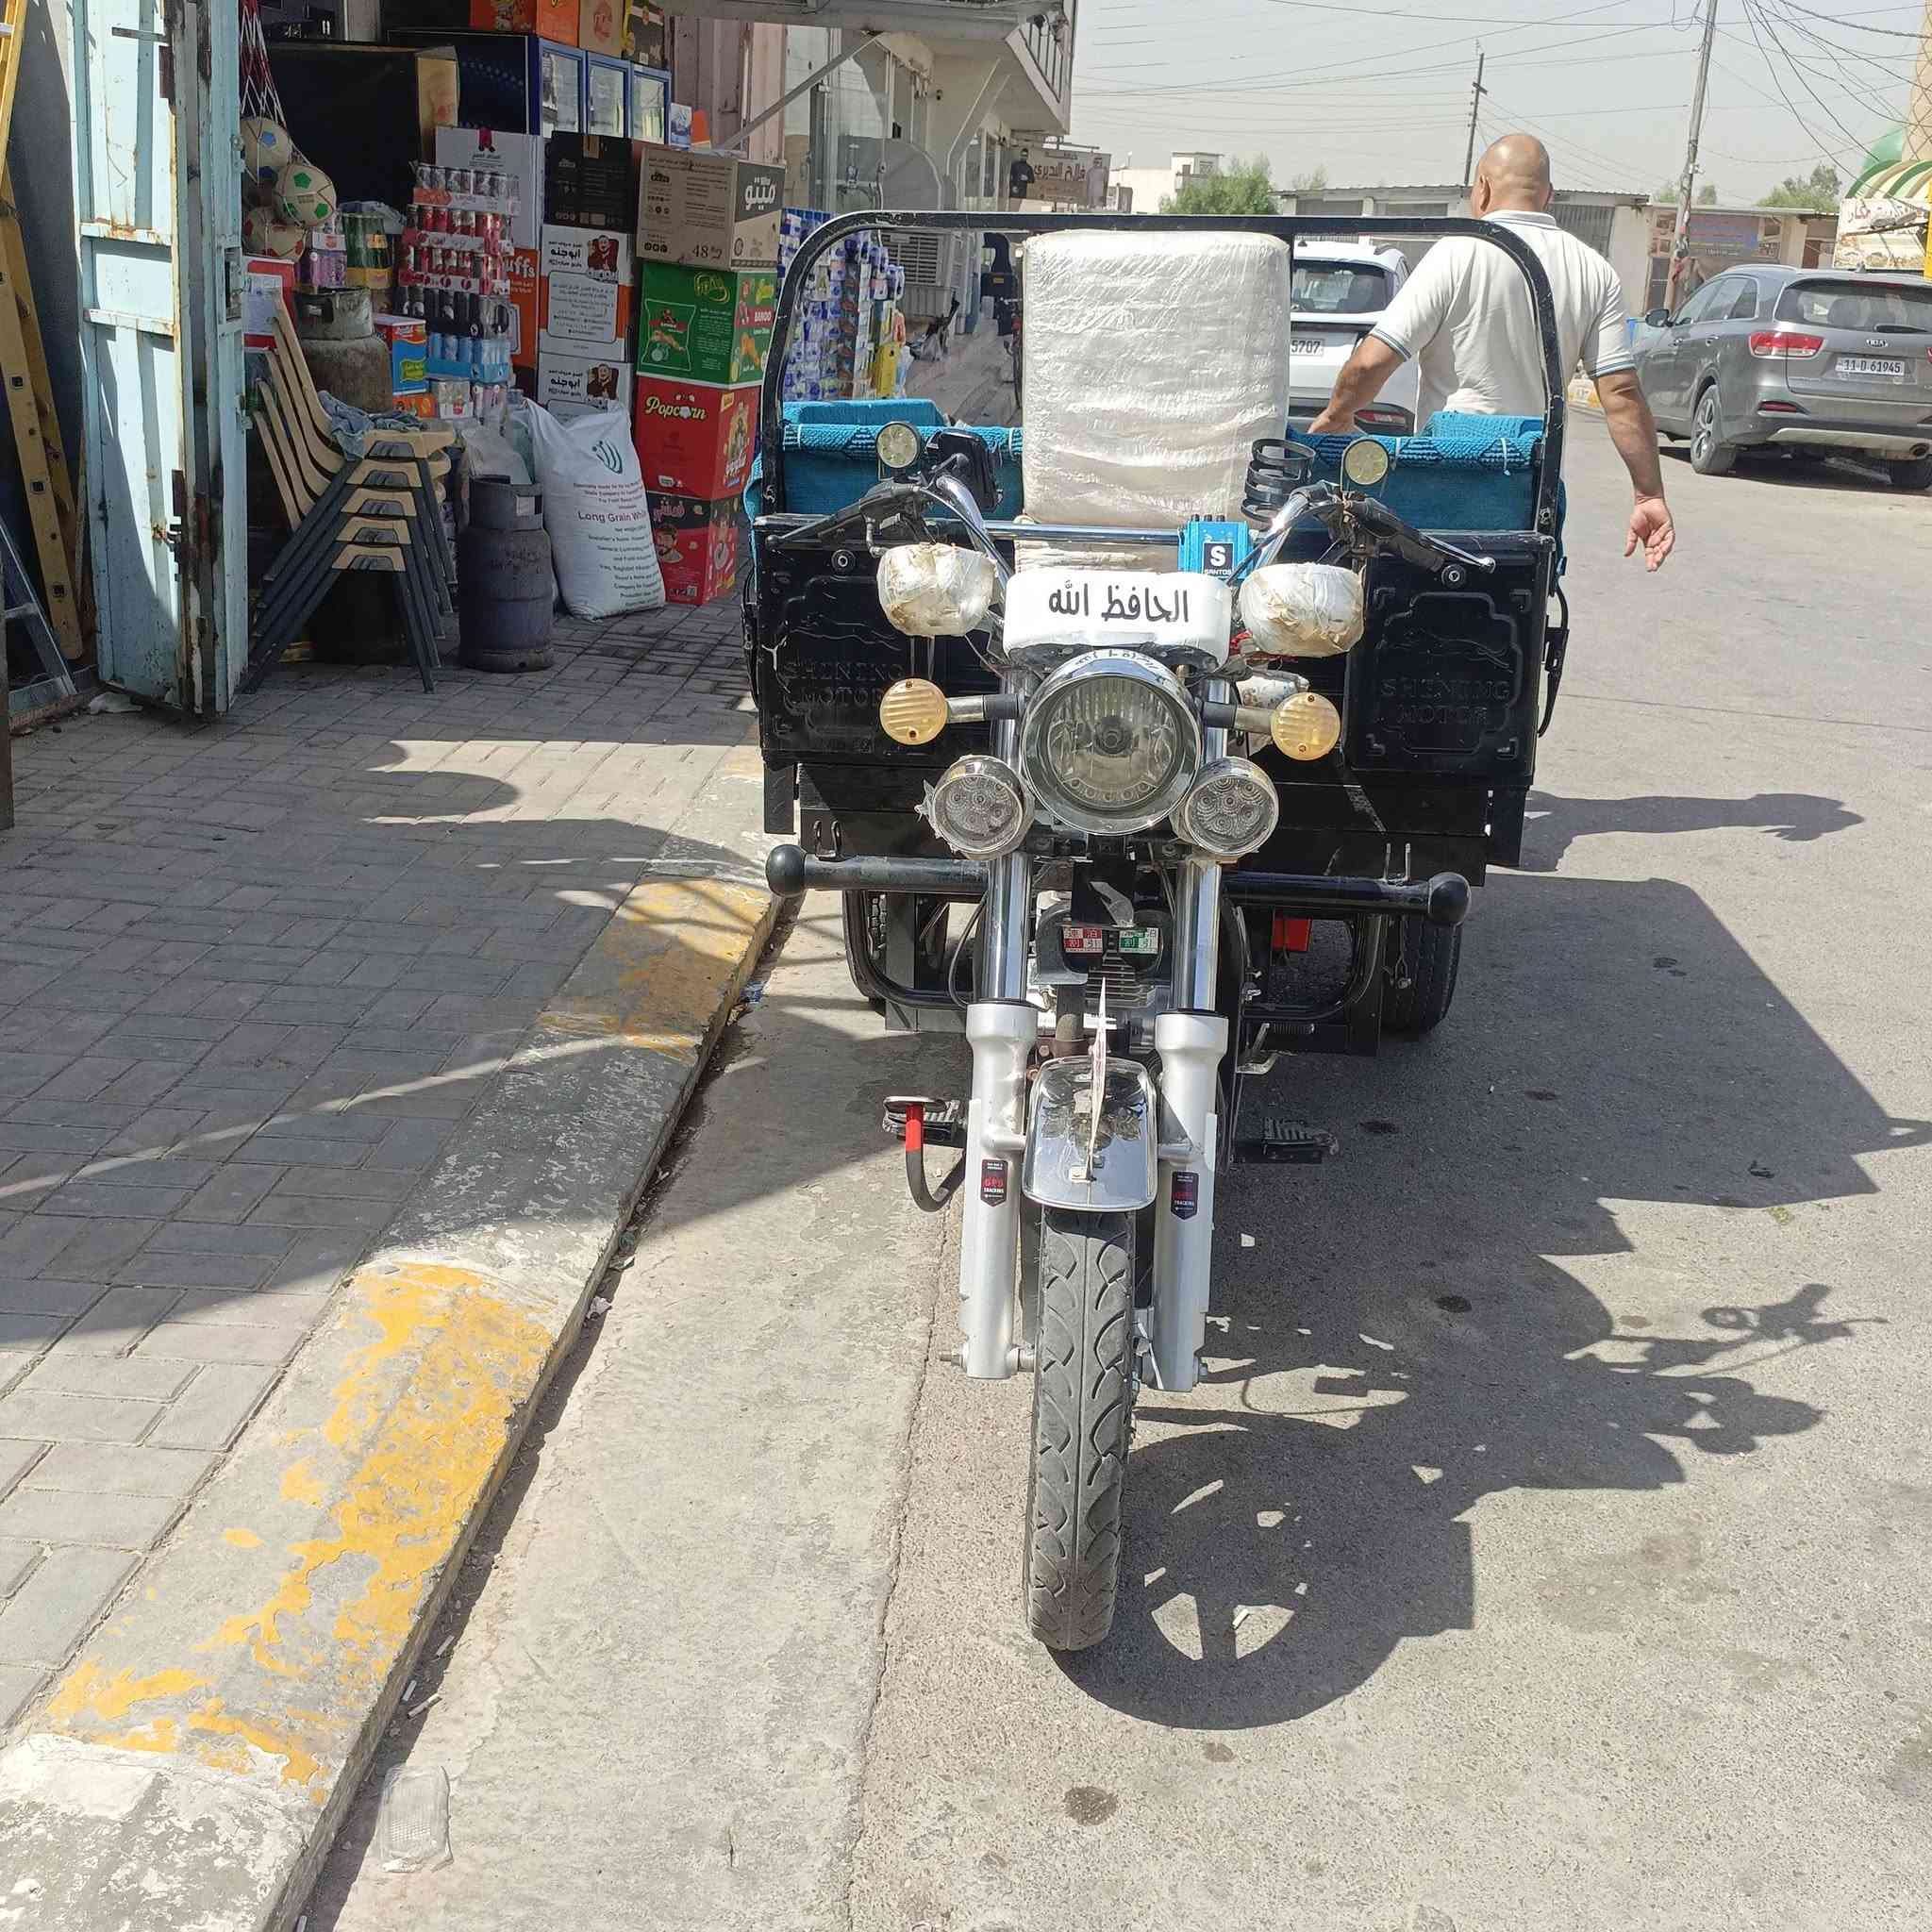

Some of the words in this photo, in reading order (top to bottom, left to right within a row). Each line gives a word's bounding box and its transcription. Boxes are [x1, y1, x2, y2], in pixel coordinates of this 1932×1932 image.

[502, 256, 535, 279] uffs
[1291, 340, 1321, 354] 5707
[644, 395, 707, 420] Popcorn
[577, 510, 606, 524] Long
[608, 512, 632, 523] Grain
[1209, 545, 1226, 567] S
[1048, 579, 1089, 617] الله
[1101, 584, 1189, 623] الحافظ
